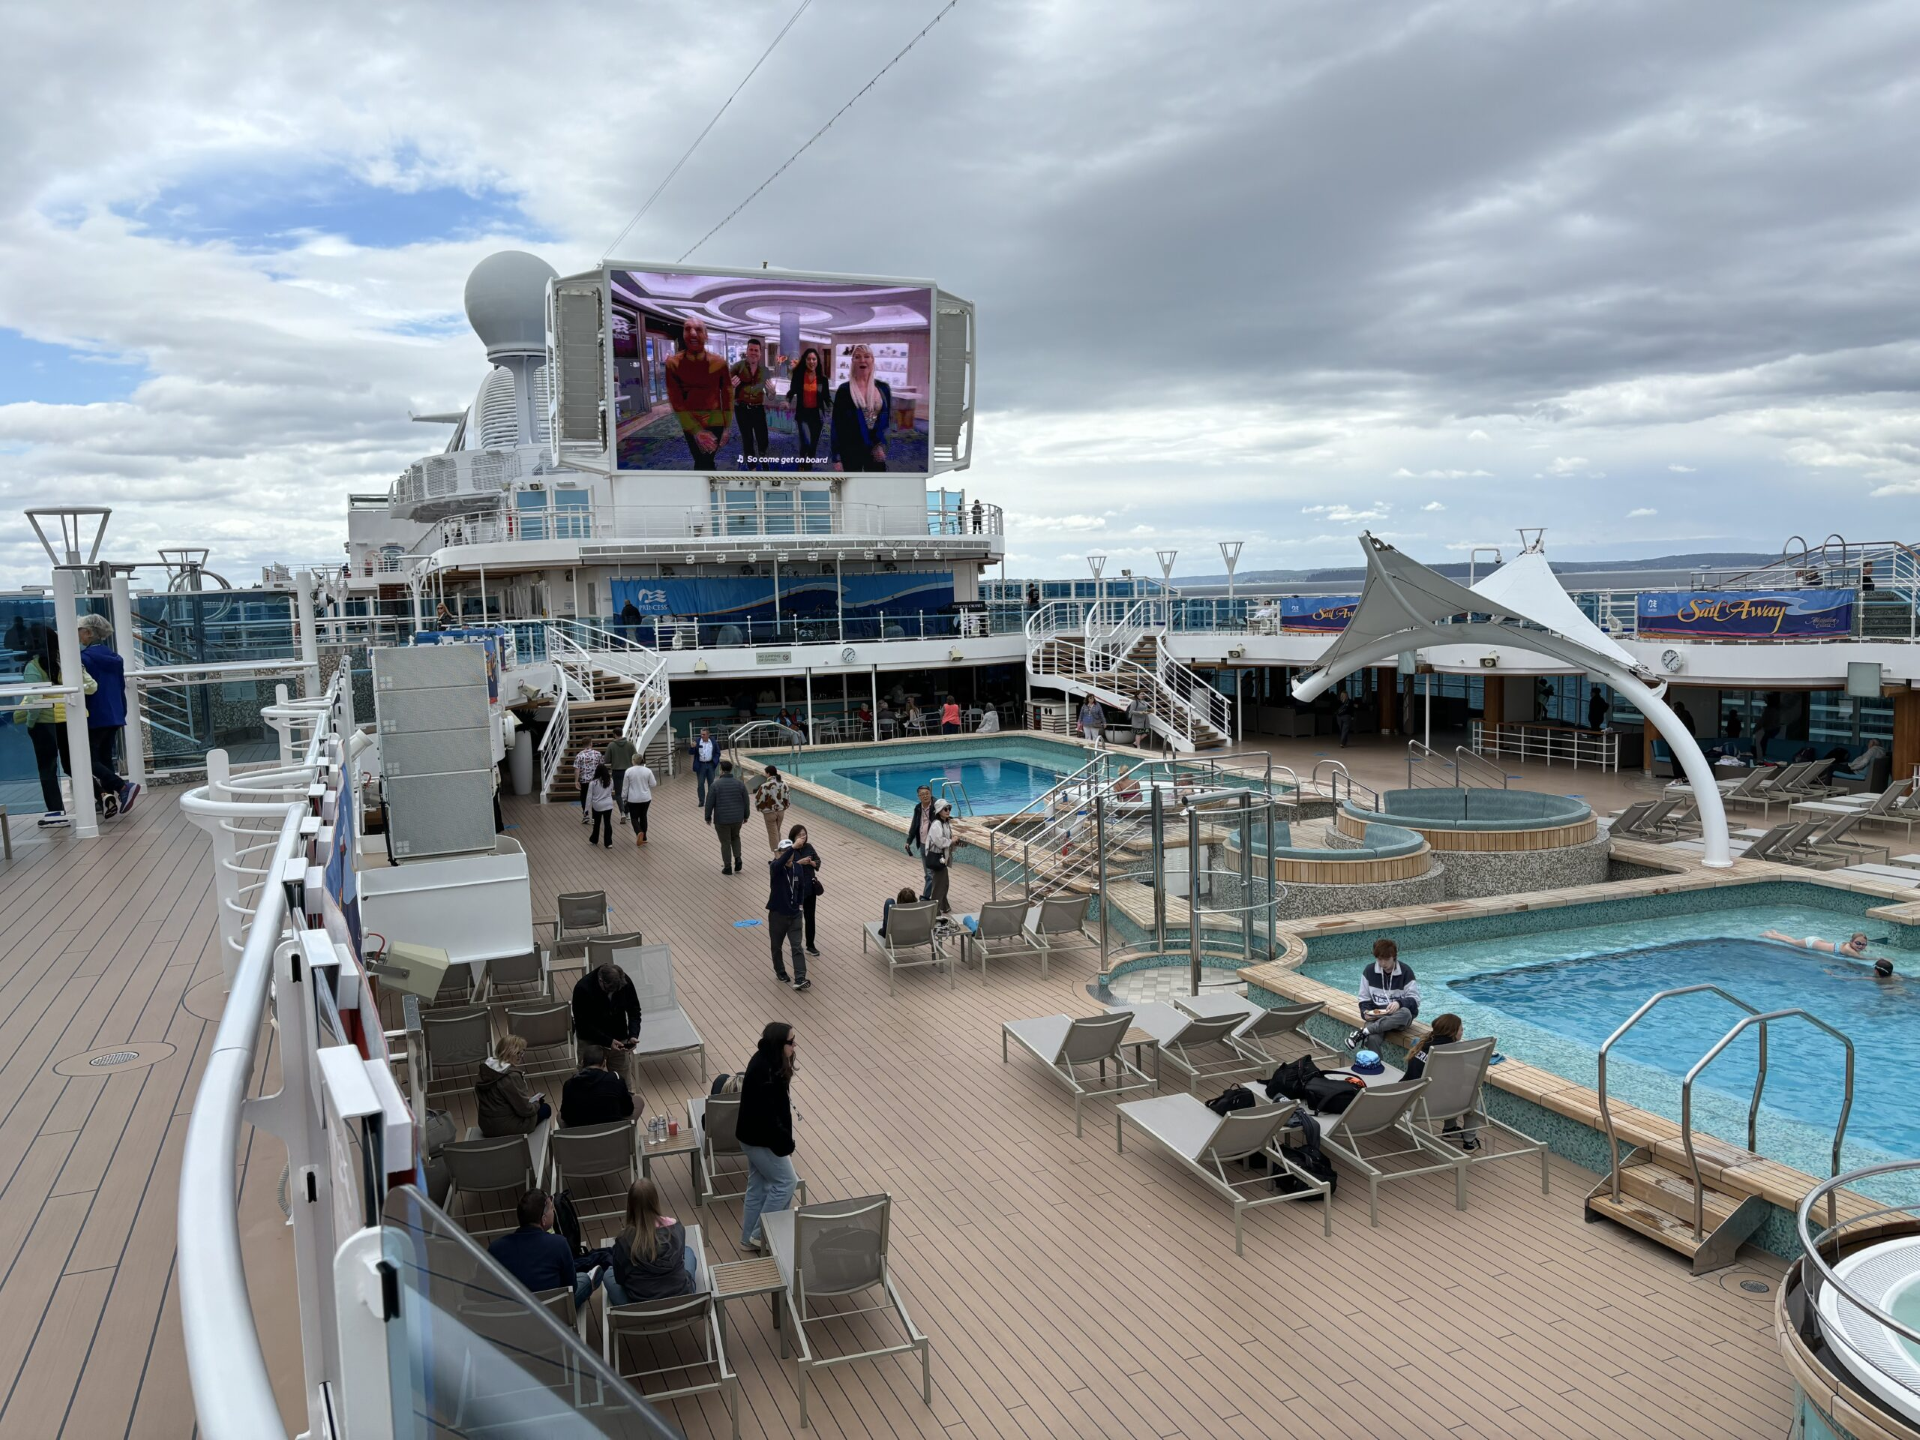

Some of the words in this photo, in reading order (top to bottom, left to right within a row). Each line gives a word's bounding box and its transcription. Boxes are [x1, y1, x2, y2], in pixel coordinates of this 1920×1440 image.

[747, 455, 757, 463] So
[781, 456, 794, 465] get
[805, 456, 828, 464] board
[1312, 607, 1335, 621] Sail
[1678, 599, 1722, 622] Sail
[1714, 600, 1786, 634] Away
